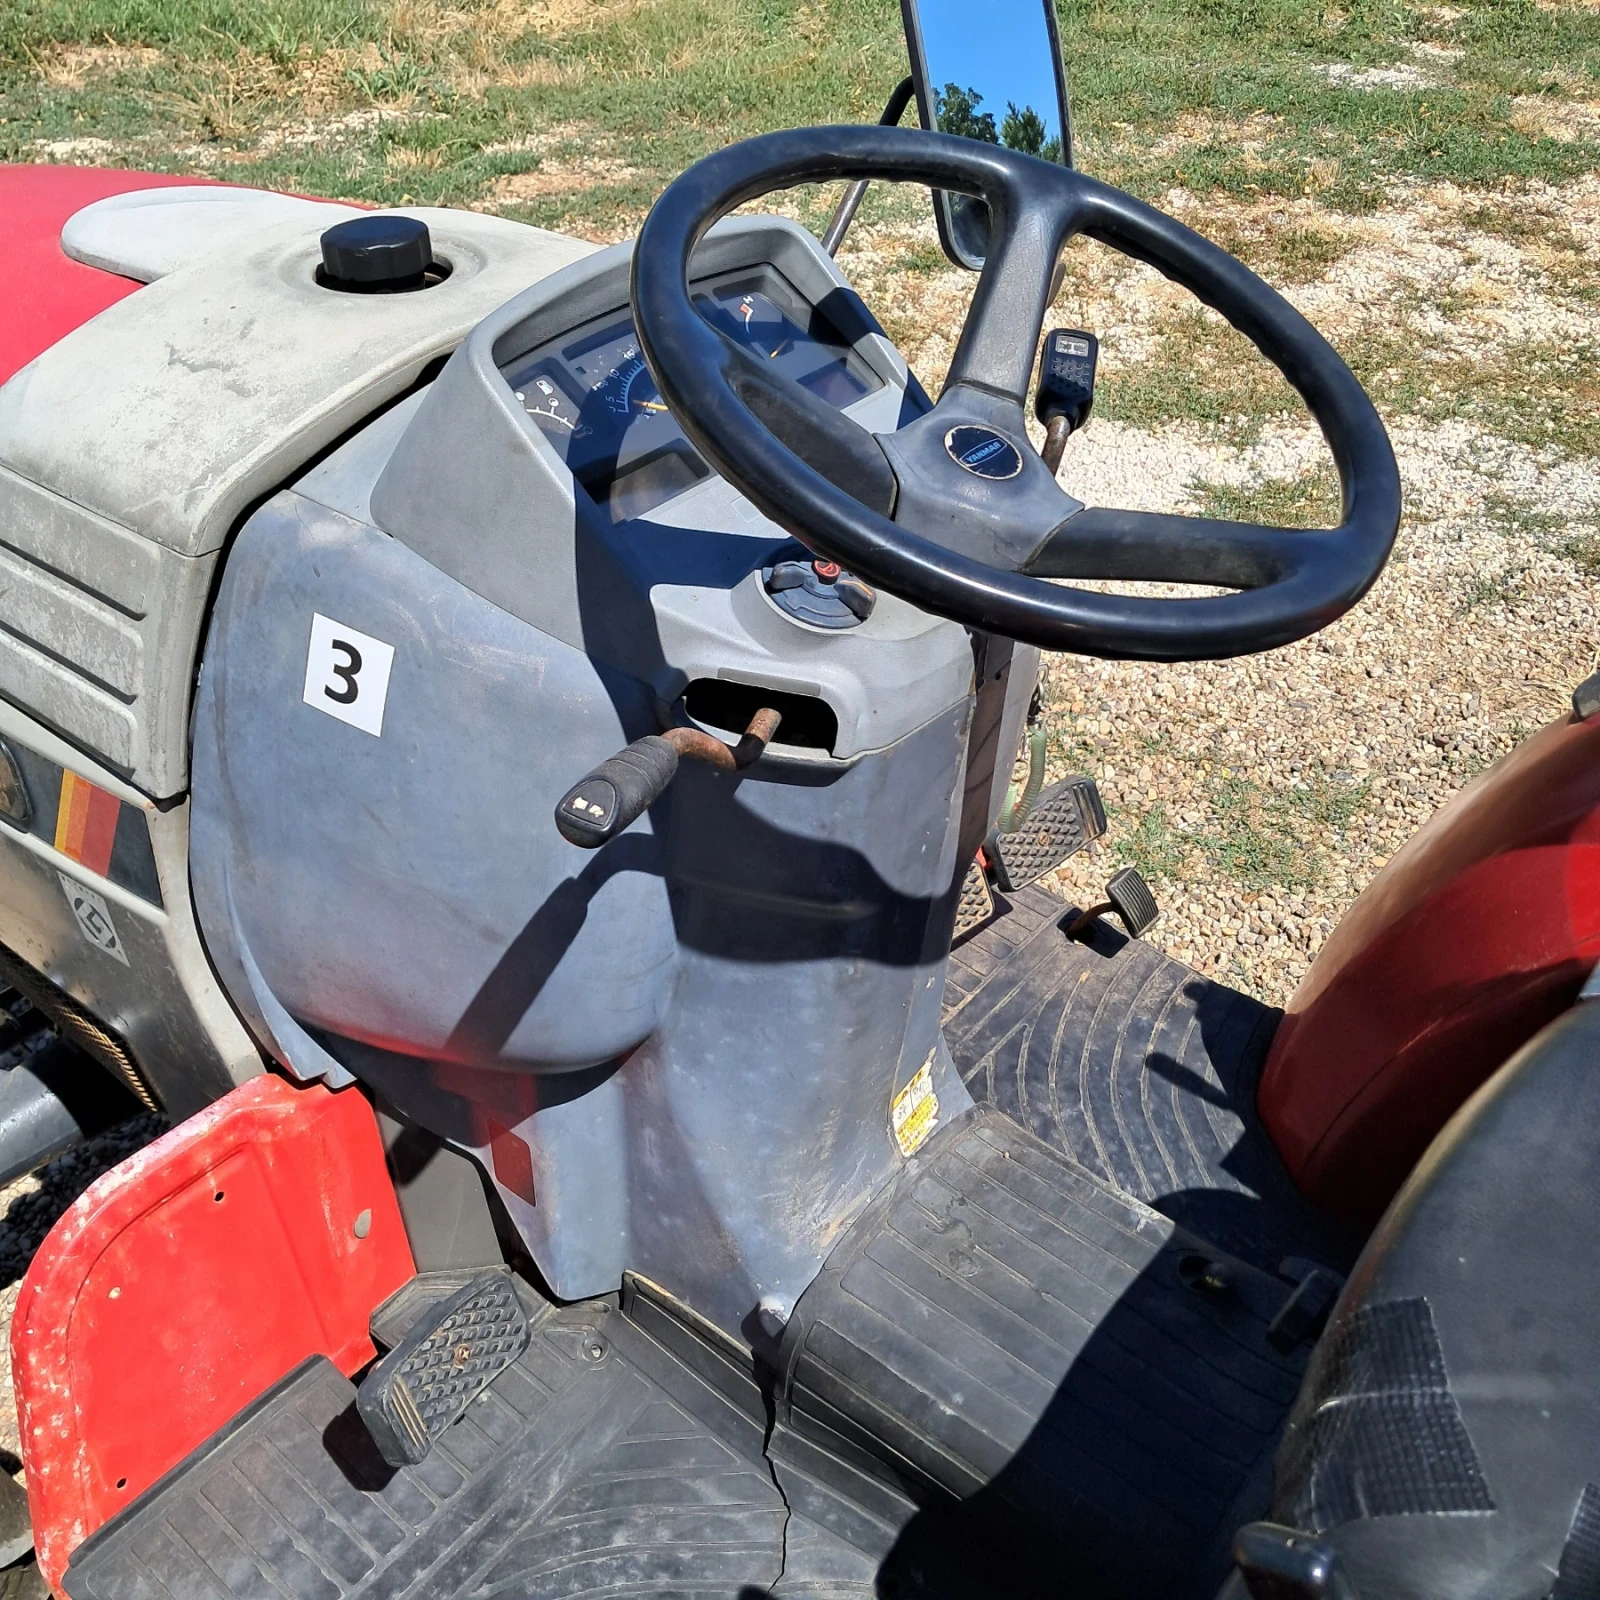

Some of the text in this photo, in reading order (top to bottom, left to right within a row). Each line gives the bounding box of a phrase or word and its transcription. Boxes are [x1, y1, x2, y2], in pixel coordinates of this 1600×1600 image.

[742, 295, 754, 304] H
[608, 368, 620, 379] 10
[965, 441, 1002, 463] YANMAR
[324, 639, 362, 705] 3
